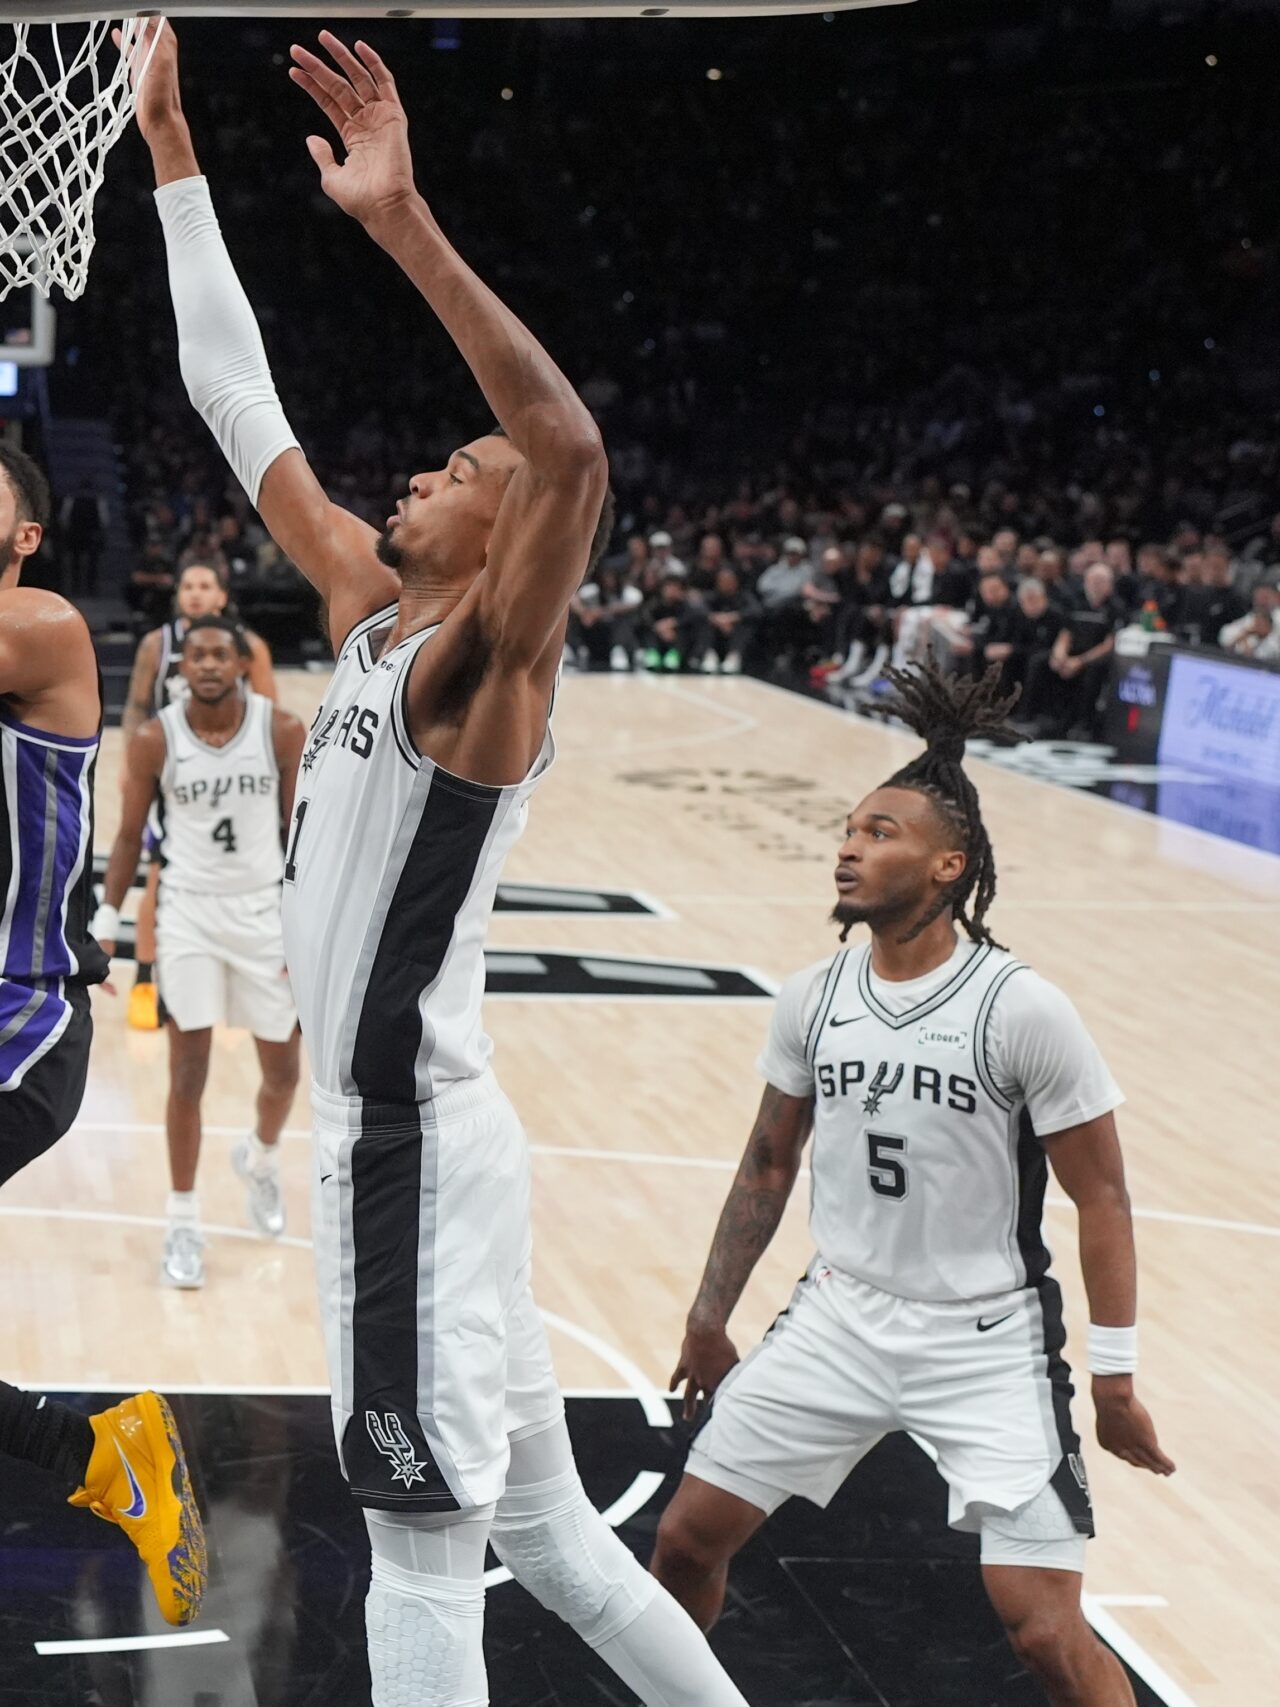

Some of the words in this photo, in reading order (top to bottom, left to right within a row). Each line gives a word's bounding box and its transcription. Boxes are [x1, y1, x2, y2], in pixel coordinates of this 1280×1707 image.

[174, 775, 273, 808] SPURS
[212, 816, 236, 853] 4
[284, 797, 310, 885] 1
[924, 1032, 960, 1044] LEDGER
[818, 1060, 976, 1117] SPURS
[864, 1129, 910, 1203] 5
